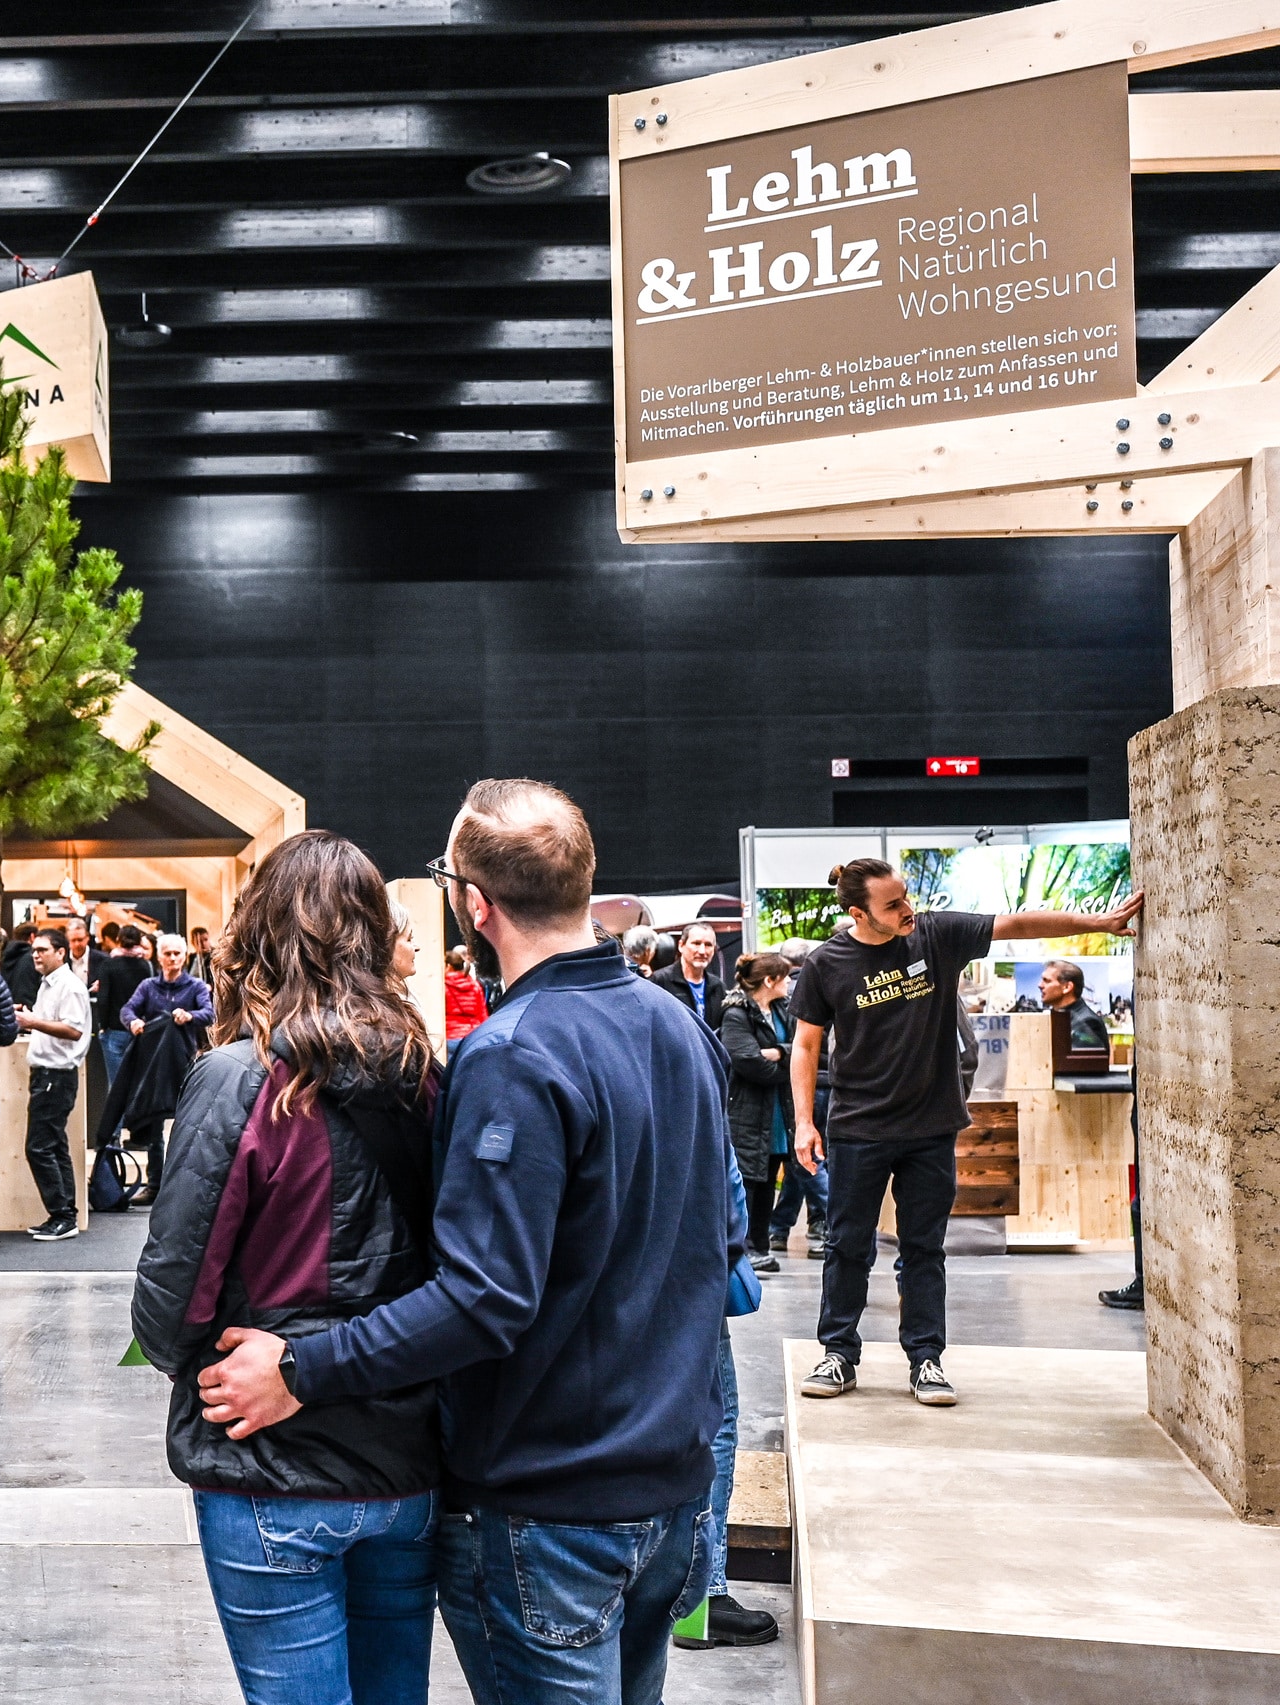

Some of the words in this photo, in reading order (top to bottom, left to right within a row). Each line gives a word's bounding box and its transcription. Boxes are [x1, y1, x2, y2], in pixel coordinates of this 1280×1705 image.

[706, 145, 917, 224] Lehm
[898, 192, 1039, 247] Regional
[637, 257, 697, 314] &
[708, 224, 881, 304] Holz
[898, 256, 1117, 320] Wohngesund
[899, 231, 1048, 283] Natürlich
[640, 387, 664, 403] Die
[667, 375, 763, 399] Vorarlberger
[766, 367, 816, 386] Lehm-
[820, 362, 832, 378] &
[981, 334, 1039, 355] stellen
[1043, 326, 1078, 346] sich
[1083, 323, 1118, 340] vor:
[640, 400, 729, 423] Ausstellung
[732, 391, 762, 410] und
[767, 384, 845, 406] Beratung,
[849, 376, 895, 394] Lehm
[899, 371, 912, 387] &
[916, 366, 954, 385] Holz
[957, 362, 994, 379] zum
[998, 350, 1078, 373] Anfassen
[1083, 341, 1118, 362] und
[641, 420, 729, 442] Mitmachen.
[733, 404, 844, 430] Vorführungen
[848, 393, 906, 416] täglich
[910, 391, 938, 407] um
[943, 386, 969, 403] 11,
[973, 381, 994, 398] 14
[998, 375, 1033, 395] und
[1038, 373, 1059, 390] 16
[1064, 368, 1098, 386] Uhr
[856, 993, 870, 1007] &
[868, 983, 902, 1004] Holz
[863, 968, 903, 989] Lehm
